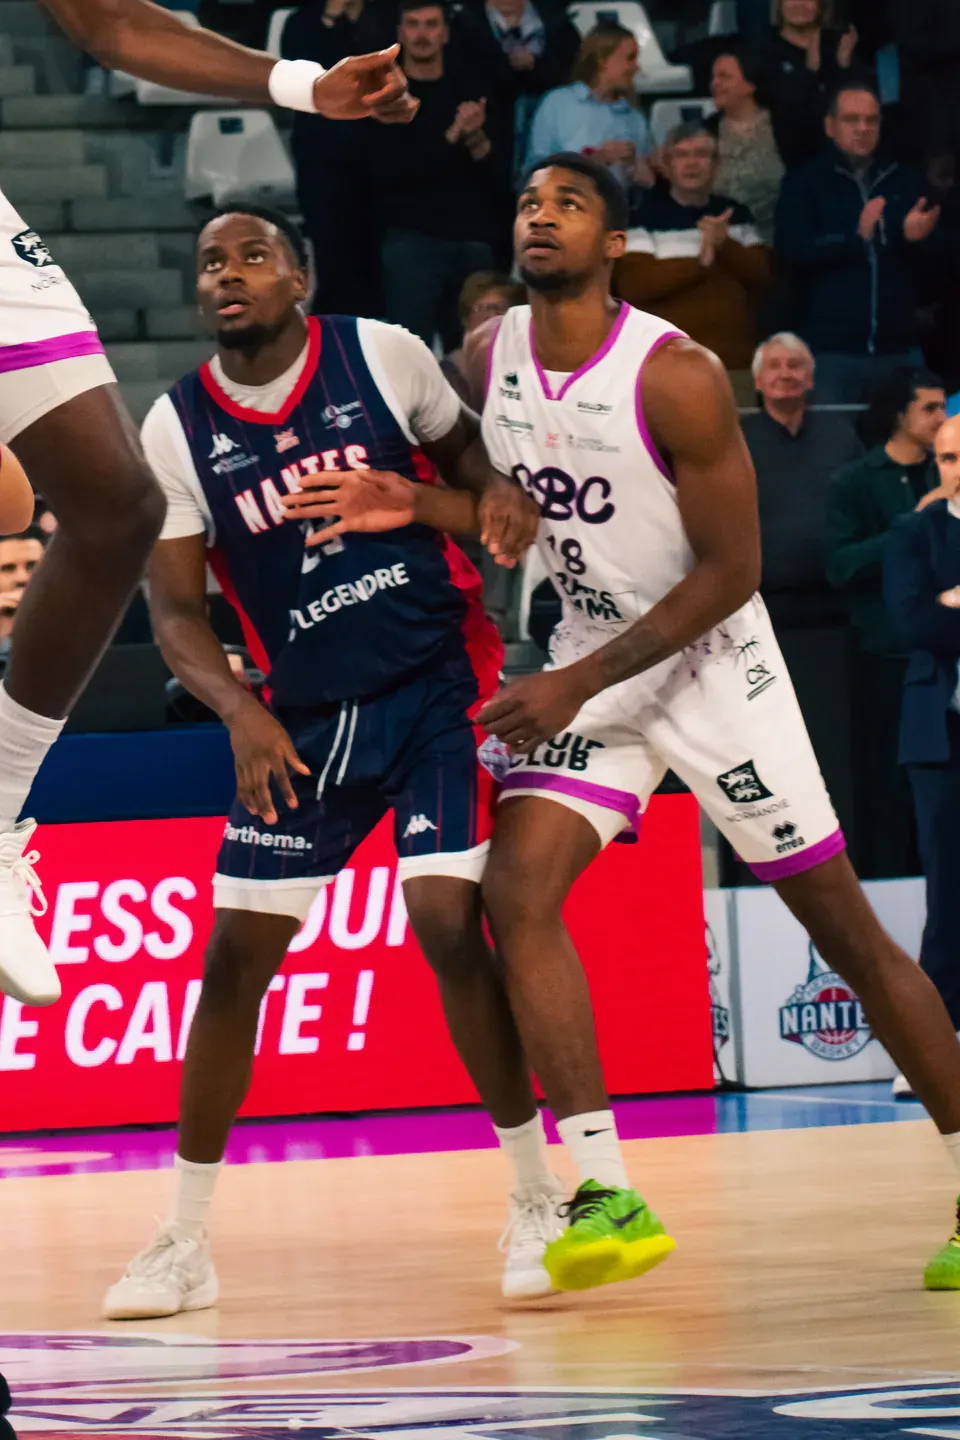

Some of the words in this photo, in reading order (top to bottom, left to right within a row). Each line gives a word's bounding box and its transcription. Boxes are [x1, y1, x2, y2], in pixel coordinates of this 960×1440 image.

[292, 562, 410, 629] LEGENDRE
[346, 970, 374, 1051] !
[780, 1001, 870, 1041] NANTE
